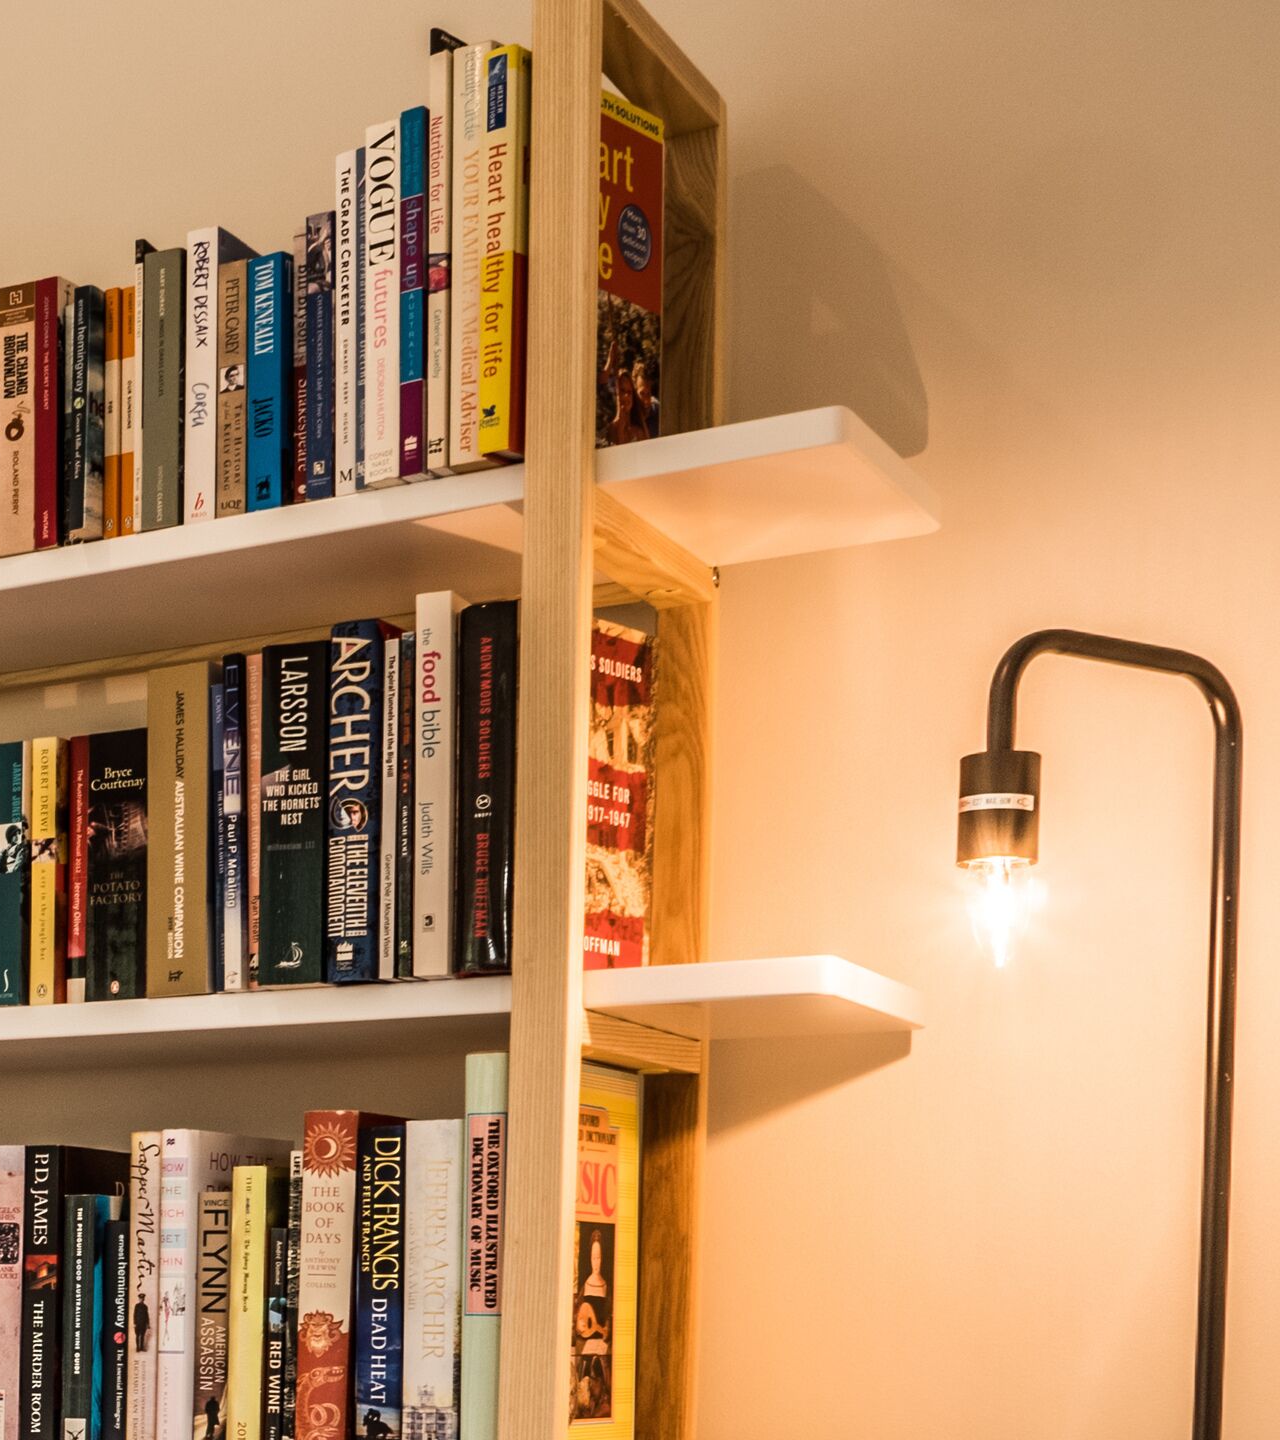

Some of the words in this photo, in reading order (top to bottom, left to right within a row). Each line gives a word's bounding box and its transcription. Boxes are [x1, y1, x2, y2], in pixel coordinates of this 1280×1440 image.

[615, 106, 659, 136] SOLUTIONS
[368, 128, 395, 266] VOGUE
[486, 143, 507, 206] Heart
[482, 212, 506, 293] healthy
[374, 269, 392, 348] futures
[485, 303, 504, 332] for
[483, 342, 502, 378] life
[599, 658, 642, 683] SOLDIERS
[279, 657, 308, 752] LARSSON
[329, 636, 371, 797] ARCHER
[90, 779, 145, 791] Courtenay
[93, 883, 141, 892] POTATO
[584, 936, 620, 957] OFFMAN
[488, 1120, 500, 1148] THE
[363, 1155, 371, 1181] AND
[373, 1137, 401, 1199] DICK
[471, 1137, 484, 1220] DICTIONARY
[487, 1152, 499, 1210] OXFORD
[362, 1186, 370, 1216] FELIX
[361, 1222, 369, 1272] FRANCIS
[372, 1204, 399, 1290] FRANCIS
[471, 1225, 482, 1243] OF
[202, 1209, 228, 1314] FLYNN
[470, 1248, 482, 1292] MUSIC
[484, 1215, 498, 1309] ILLUSTRATED
[32, 1301, 44, 1327] THE
[371, 1298, 388, 1351] DEAD
[31, 1332, 43, 1388] MURDER
[269, 1341, 282, 1370] RED
[267, 1374, 280, 1414] WINE
[370, 1355, 386, 1403] HEAT
[30, 1393, 42, 1433] ROOM
